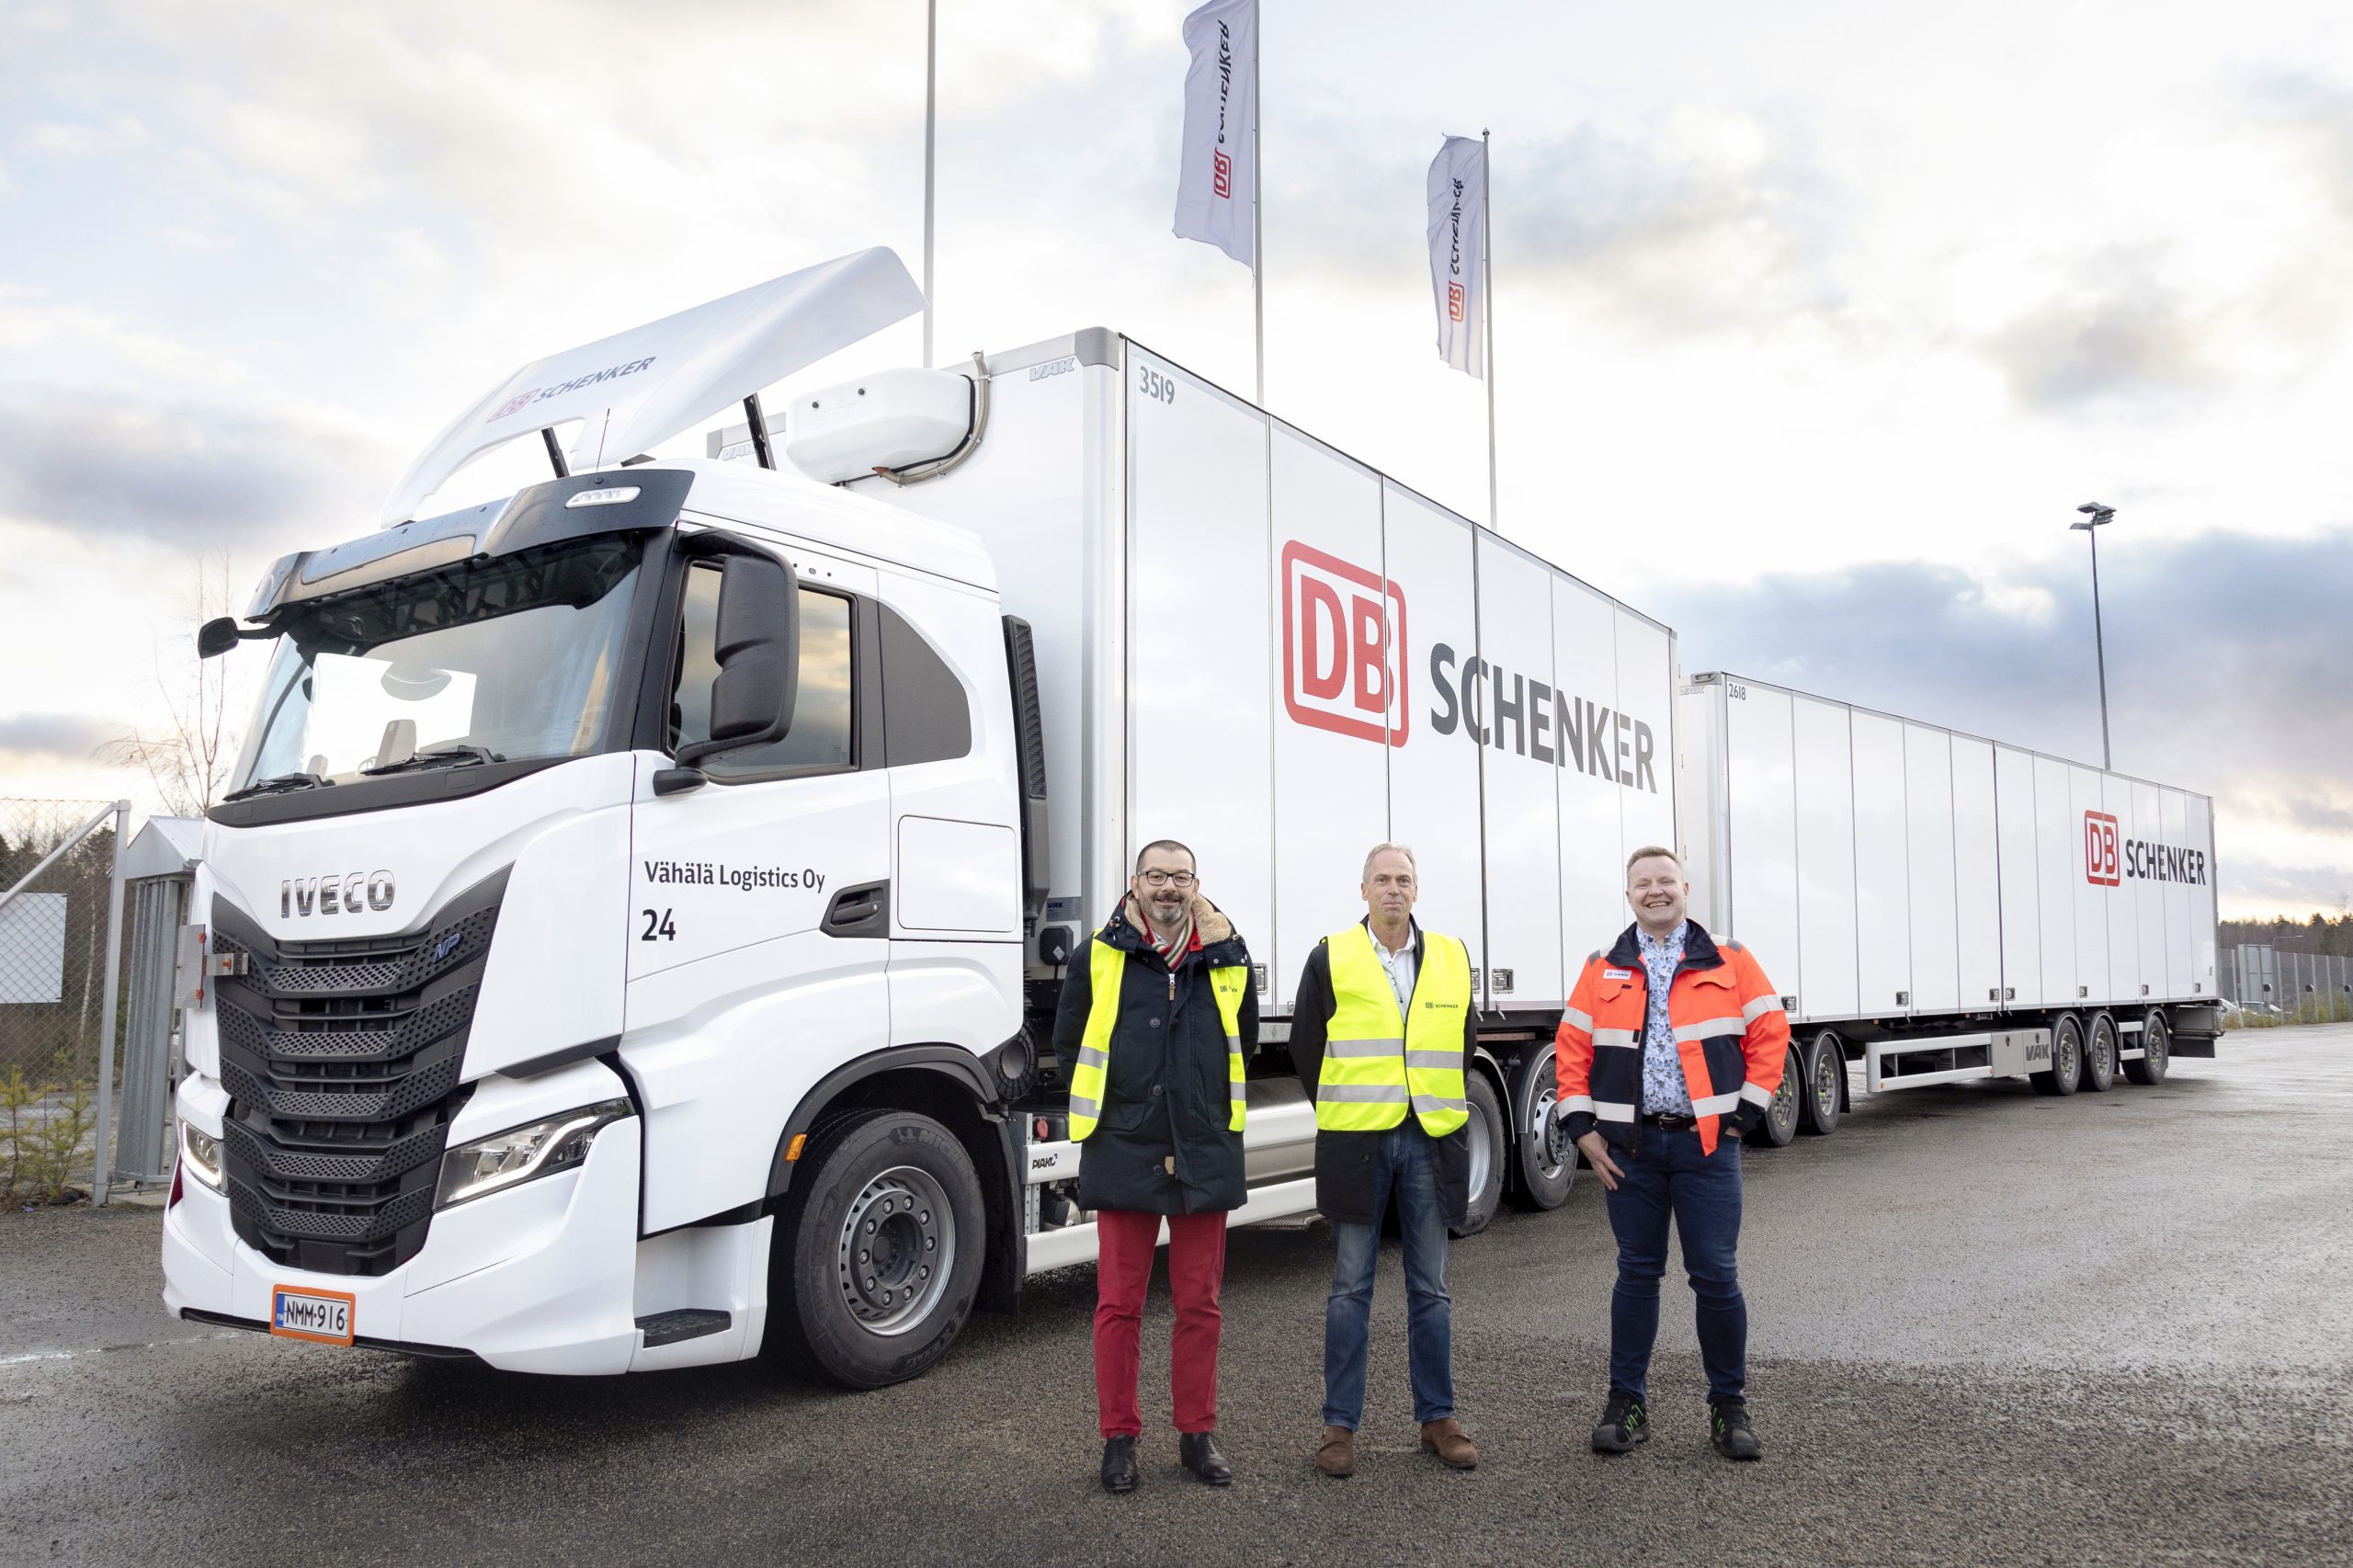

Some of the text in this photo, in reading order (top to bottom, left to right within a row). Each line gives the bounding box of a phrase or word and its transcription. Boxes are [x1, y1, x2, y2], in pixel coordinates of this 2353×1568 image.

[532, 356, 657, 403] SCHENKER
[1029, 357, 1075, 382] VAK
[1139, 365, 1176, 405] 3519
[1298, 571, 1658, 795] DB SCHENKER
[1728, 683, 1746, 701] 2618
[2088, 820, 2207, 886] DB SCHENKER
[643, 860, 825, 893] Vähälä Logistics Oy
[280, 869, 396, 919] IVECO
[641, 907, 676, 941] 24
[432, 933, 460, 964] NP
[2025, 1043, 2051, 1062] VAK
[286, 1300, 346, 1332] NMM-916
